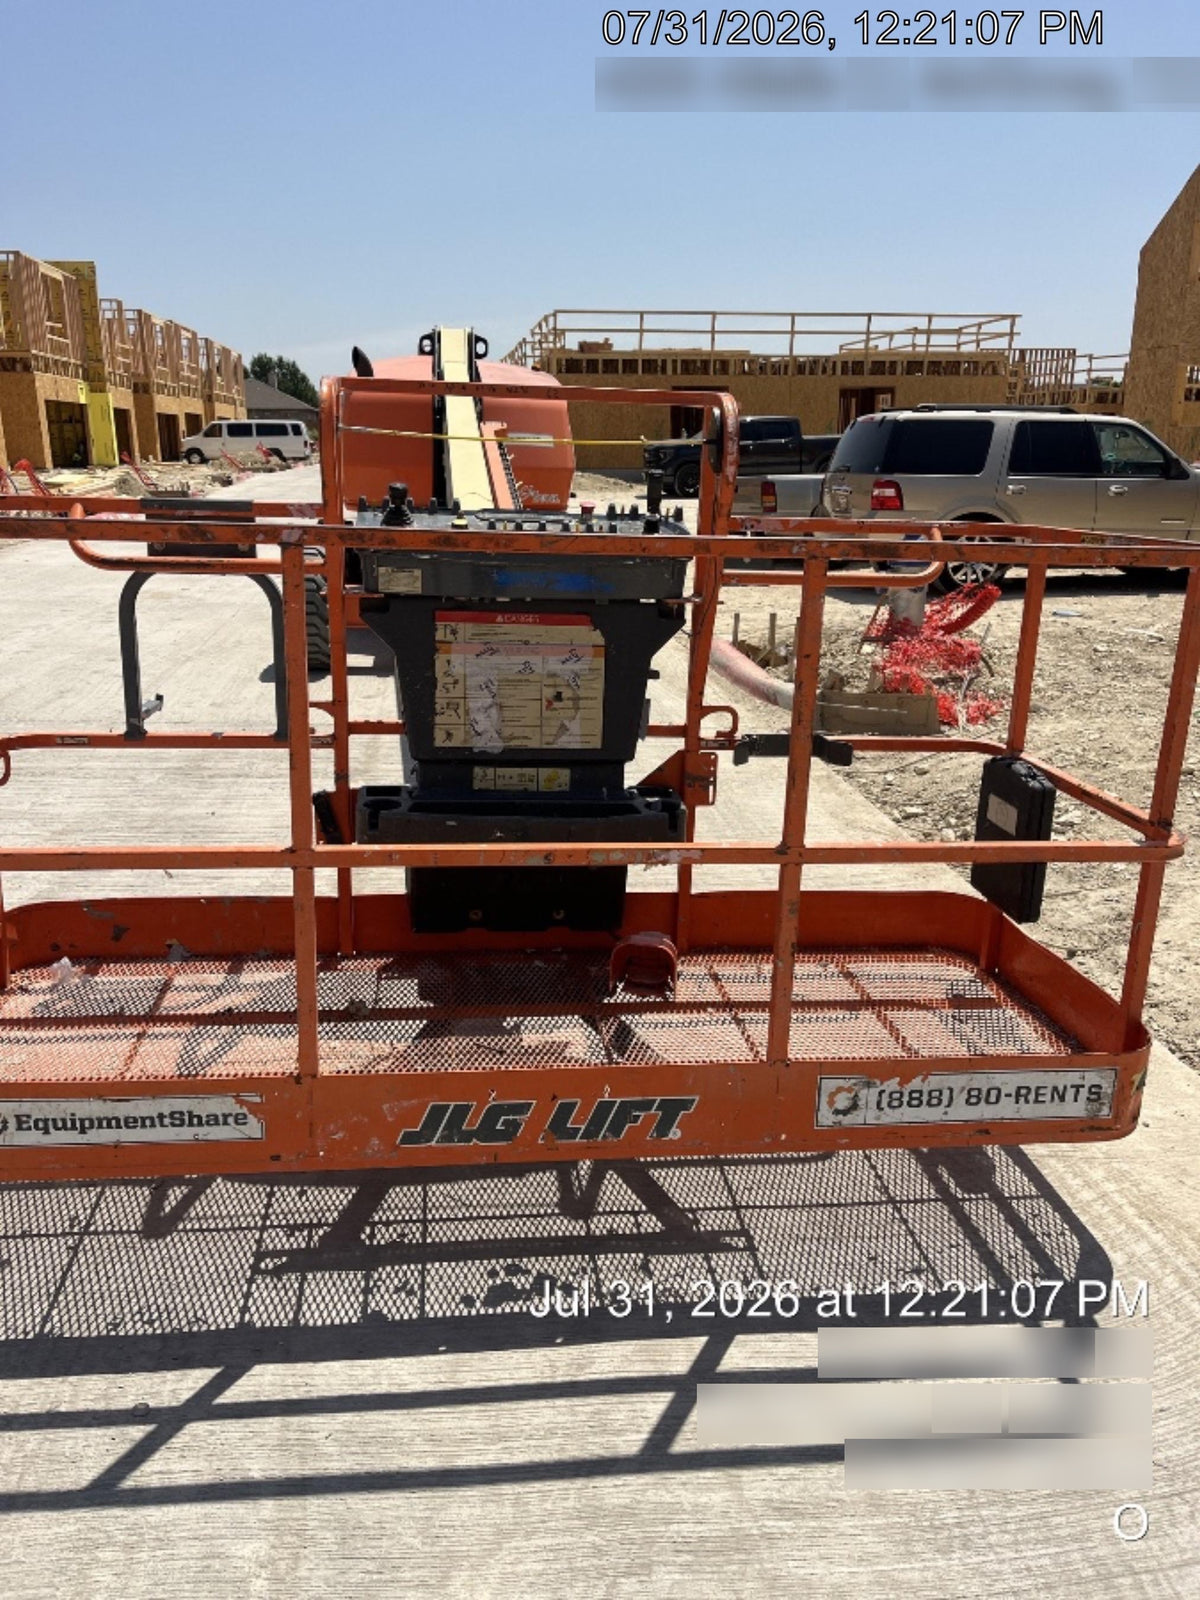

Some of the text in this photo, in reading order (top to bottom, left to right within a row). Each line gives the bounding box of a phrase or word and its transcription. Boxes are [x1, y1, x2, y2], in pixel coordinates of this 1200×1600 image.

[876, 1083, 1104, 1112] (888) 80-RENTS
[14, 1110, 249, 1135] EquipmentShare
[397, 1100, 537, 1147] JLG
